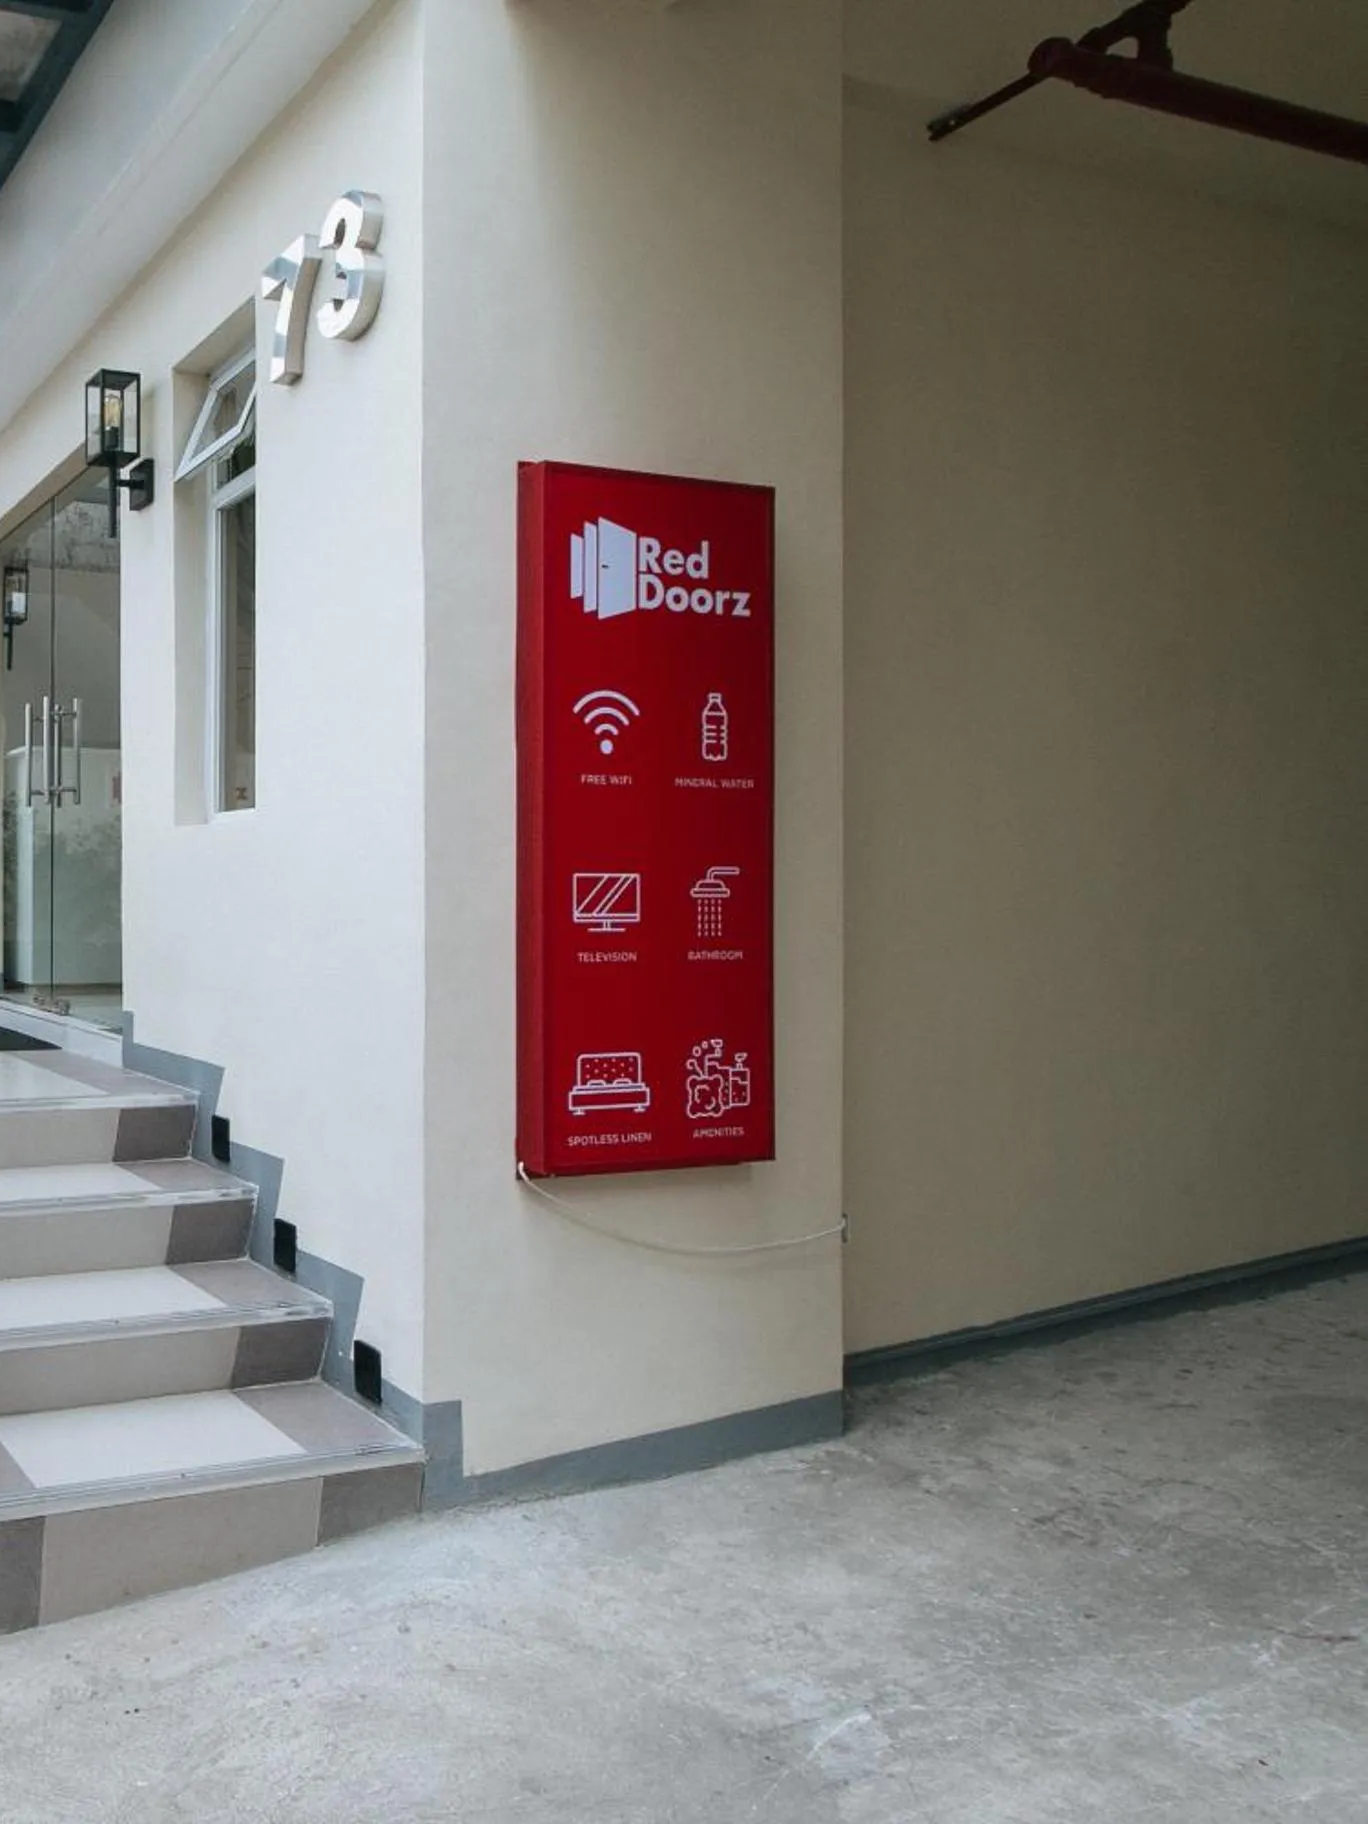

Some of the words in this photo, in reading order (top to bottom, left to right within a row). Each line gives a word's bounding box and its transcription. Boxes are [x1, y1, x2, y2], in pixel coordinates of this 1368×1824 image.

[638, 536, 709, 580] Red
[638, 574, 751, 617] Doorz
[581, 773, 606, 786] FREE
[675, 777, 717, 789] MINERAL
[720, 779, 754, 790] WATER
[577, 951, 637, 963] TELEVISION
[688, 950, 743, 961] BATHROOM
[568, 1132, 619, 1147] SPOTLESS
[621, 1131, 652, 1144] LINEN
[693, 1126, 745, 1139] AMENITIES
